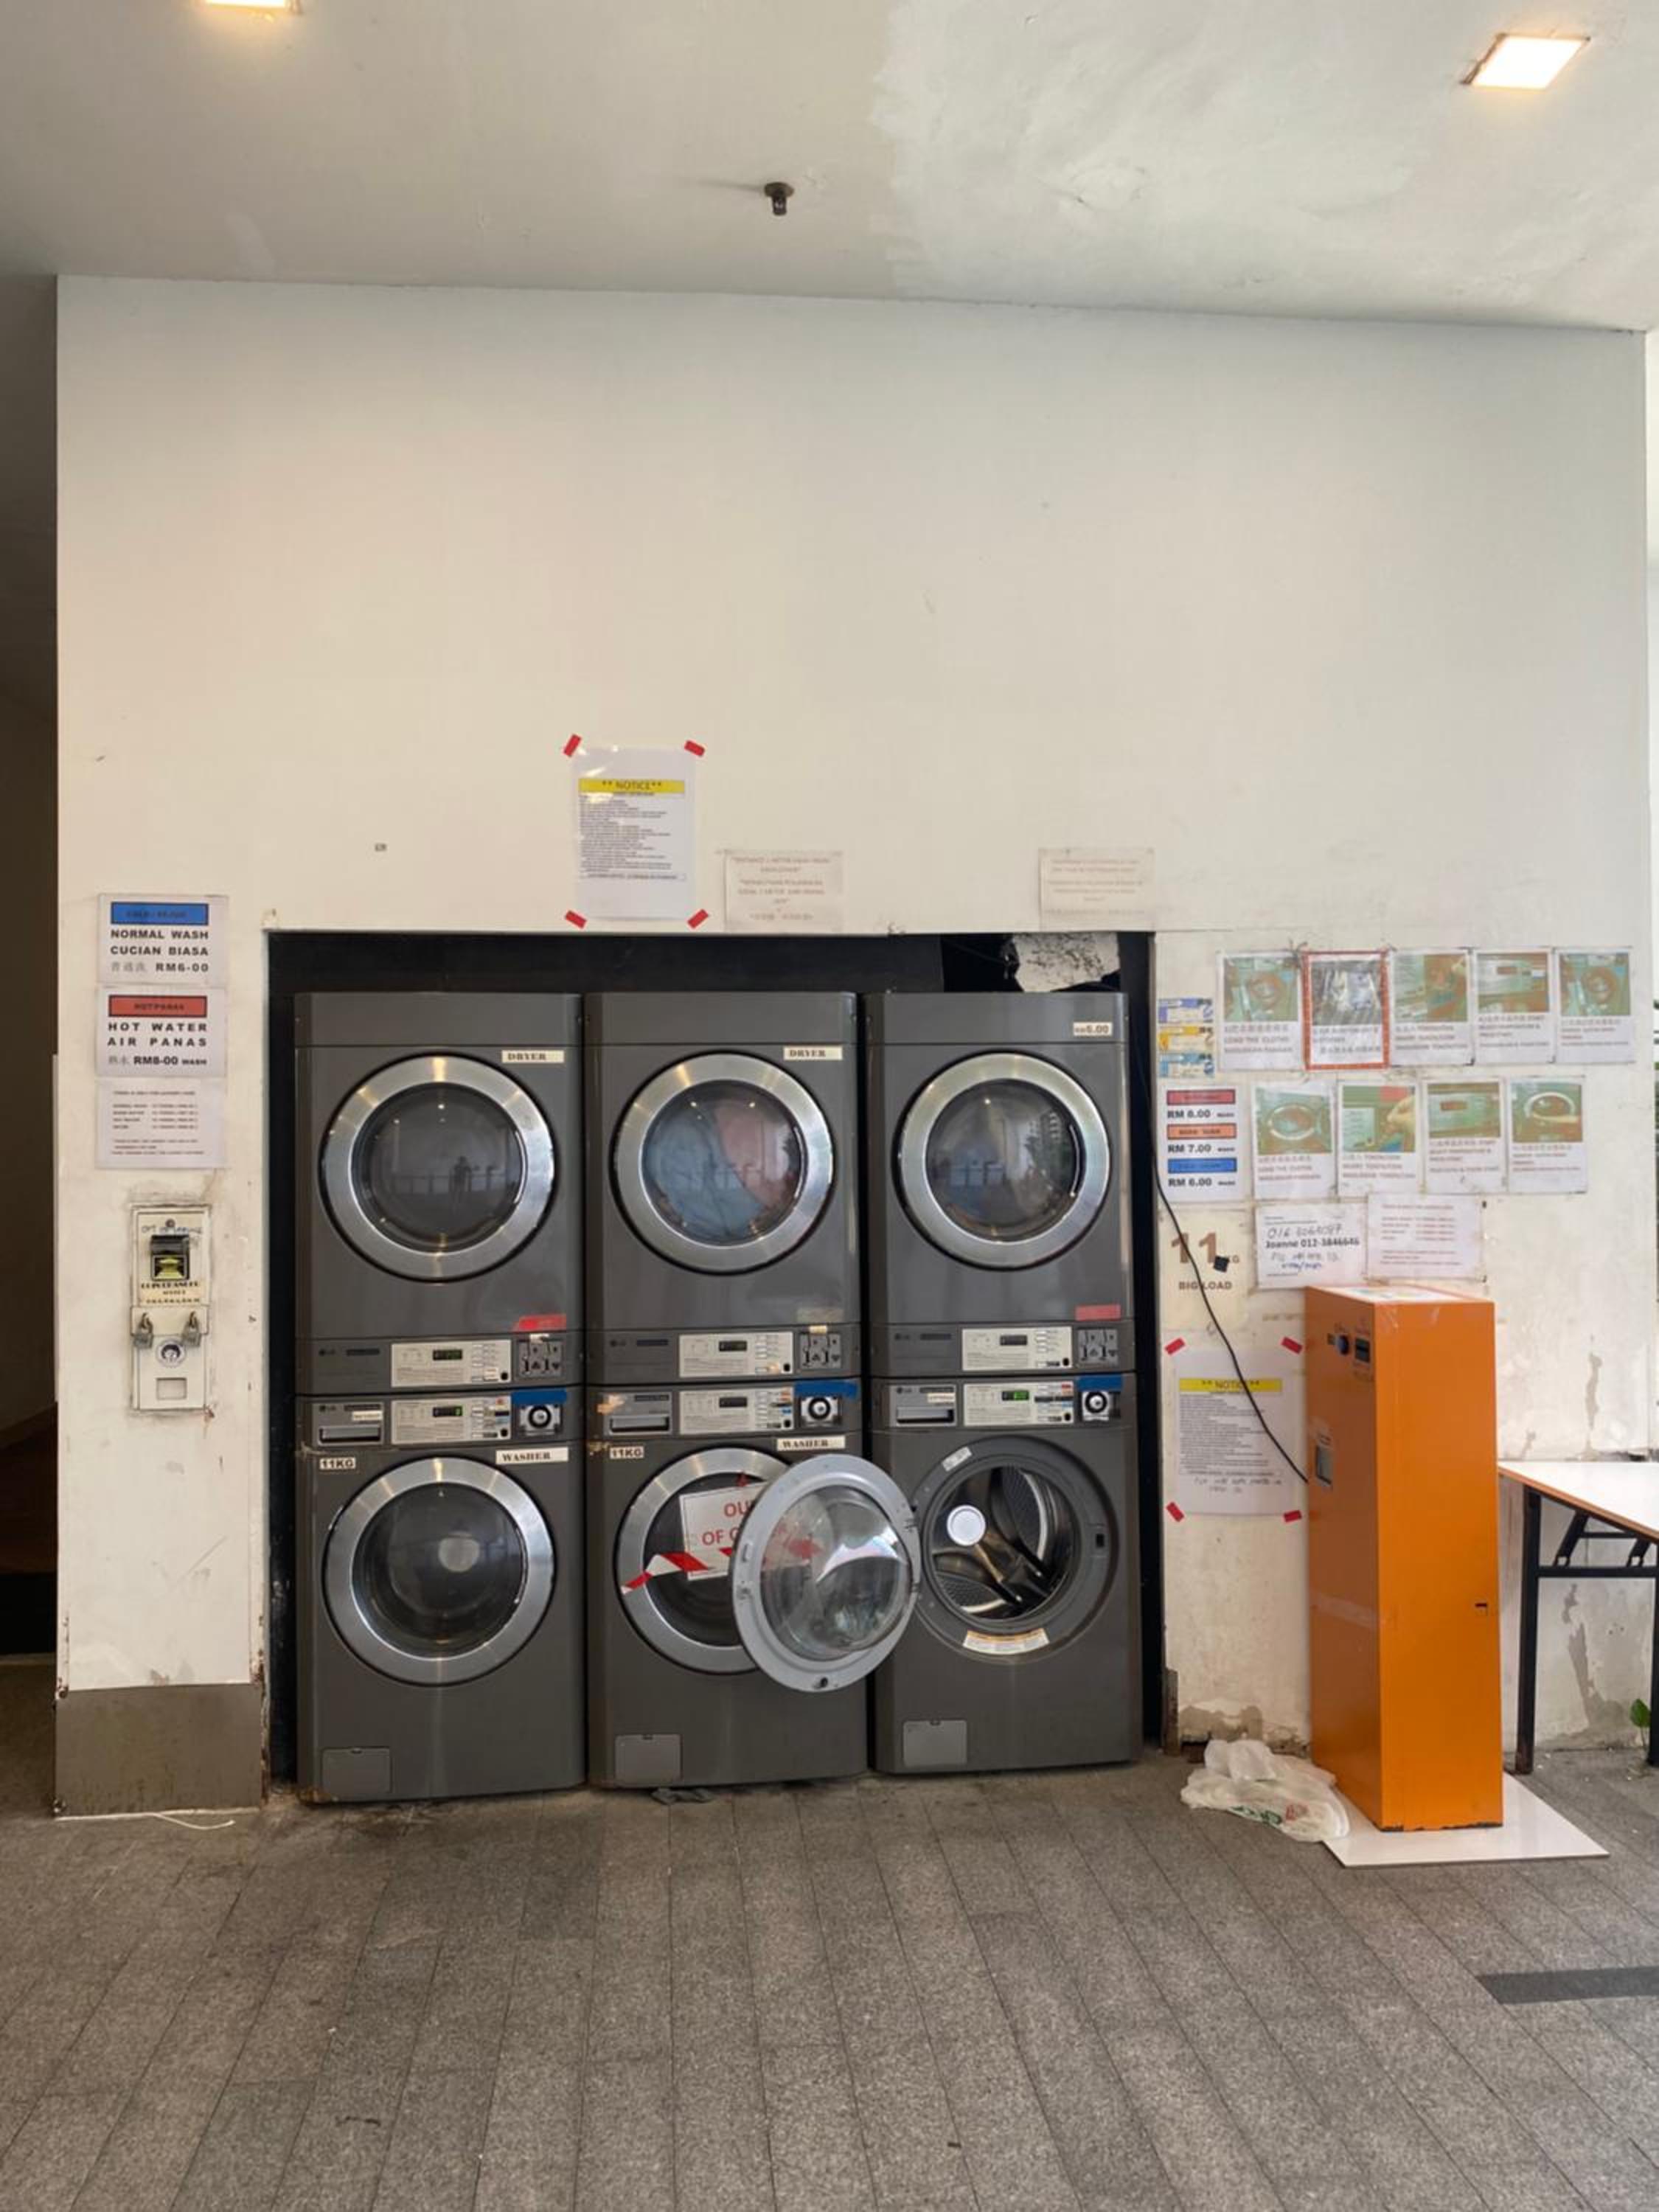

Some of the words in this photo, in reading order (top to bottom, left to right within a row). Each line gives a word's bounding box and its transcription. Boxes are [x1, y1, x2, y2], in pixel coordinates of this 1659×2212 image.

[111, 930, 164, 939] NORMAL
[171, 931, 209, 940] WASH
[110, 946, 161, 956] CUCIAN
[169, 947, 209, 956] BIASA
[156, 963, 209, 973] RM6-00
[108, 1022, 140, 1032] HOT
[151, 1023, 207, 1032] WATER
[108, 1037, 136, 1046] AIR
[150, 1037, 206, 1047] PANAS
[507, 1052, 546, 1061] DRYER
[789, 1049, 827, 1057] DRYER
[1167, 1110, 1185, 1119] RM
[1167, 1144, 1185, 1152] RM
[1188, 1144, 1212, 1152] 7.00
[1168, 1178, 1186, 1187] RM
[1178, 1281, 1199, 1290] BIG
[1202, 1280, 1233, 1290] LOAD
[782, 1440, 828, 1449] WASHER
[502, 1451, 551, 1462] WASHER
[611, 1449, 642, 1457] 11KG
[321, 1460, 354, 1468] 11KG
[702, 1528, 724, 1546] OF
